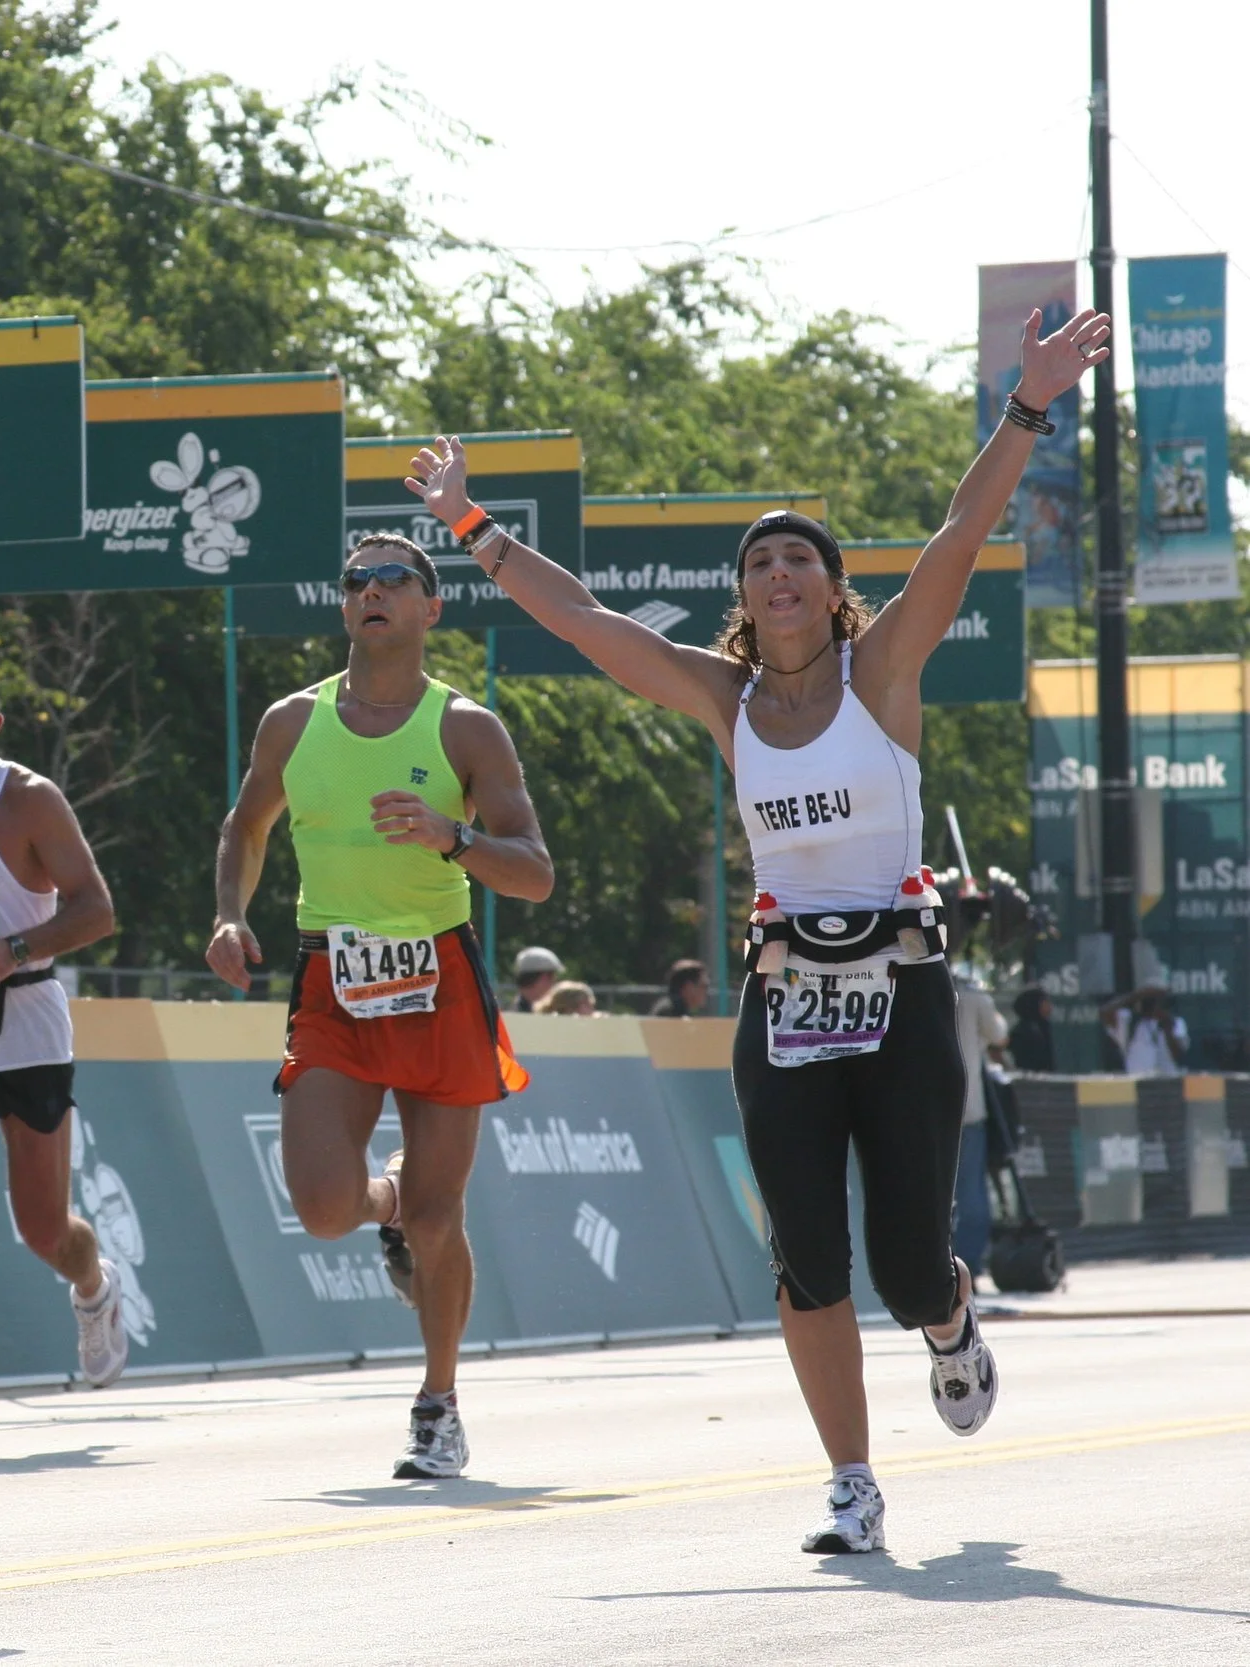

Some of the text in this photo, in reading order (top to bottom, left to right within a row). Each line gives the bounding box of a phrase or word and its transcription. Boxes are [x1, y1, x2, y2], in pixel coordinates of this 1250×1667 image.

[1133, 323, 1212, 355] Chicago
[84, 500, 180, 537] nergizer
[581, 562, 739, 590] ank of Americ
[1144, 754, 1227, 789] Bank
[754, 788, 851, 831] TERE BE-U
[1176, 858, 1250, 891] LaSa
[335, 939, 436, 984] A 1492
[767, 988, 889, 1033] B 2599
[492, 1117, 552, 1173] Bank
[558, 1117, 643, 1173] America
